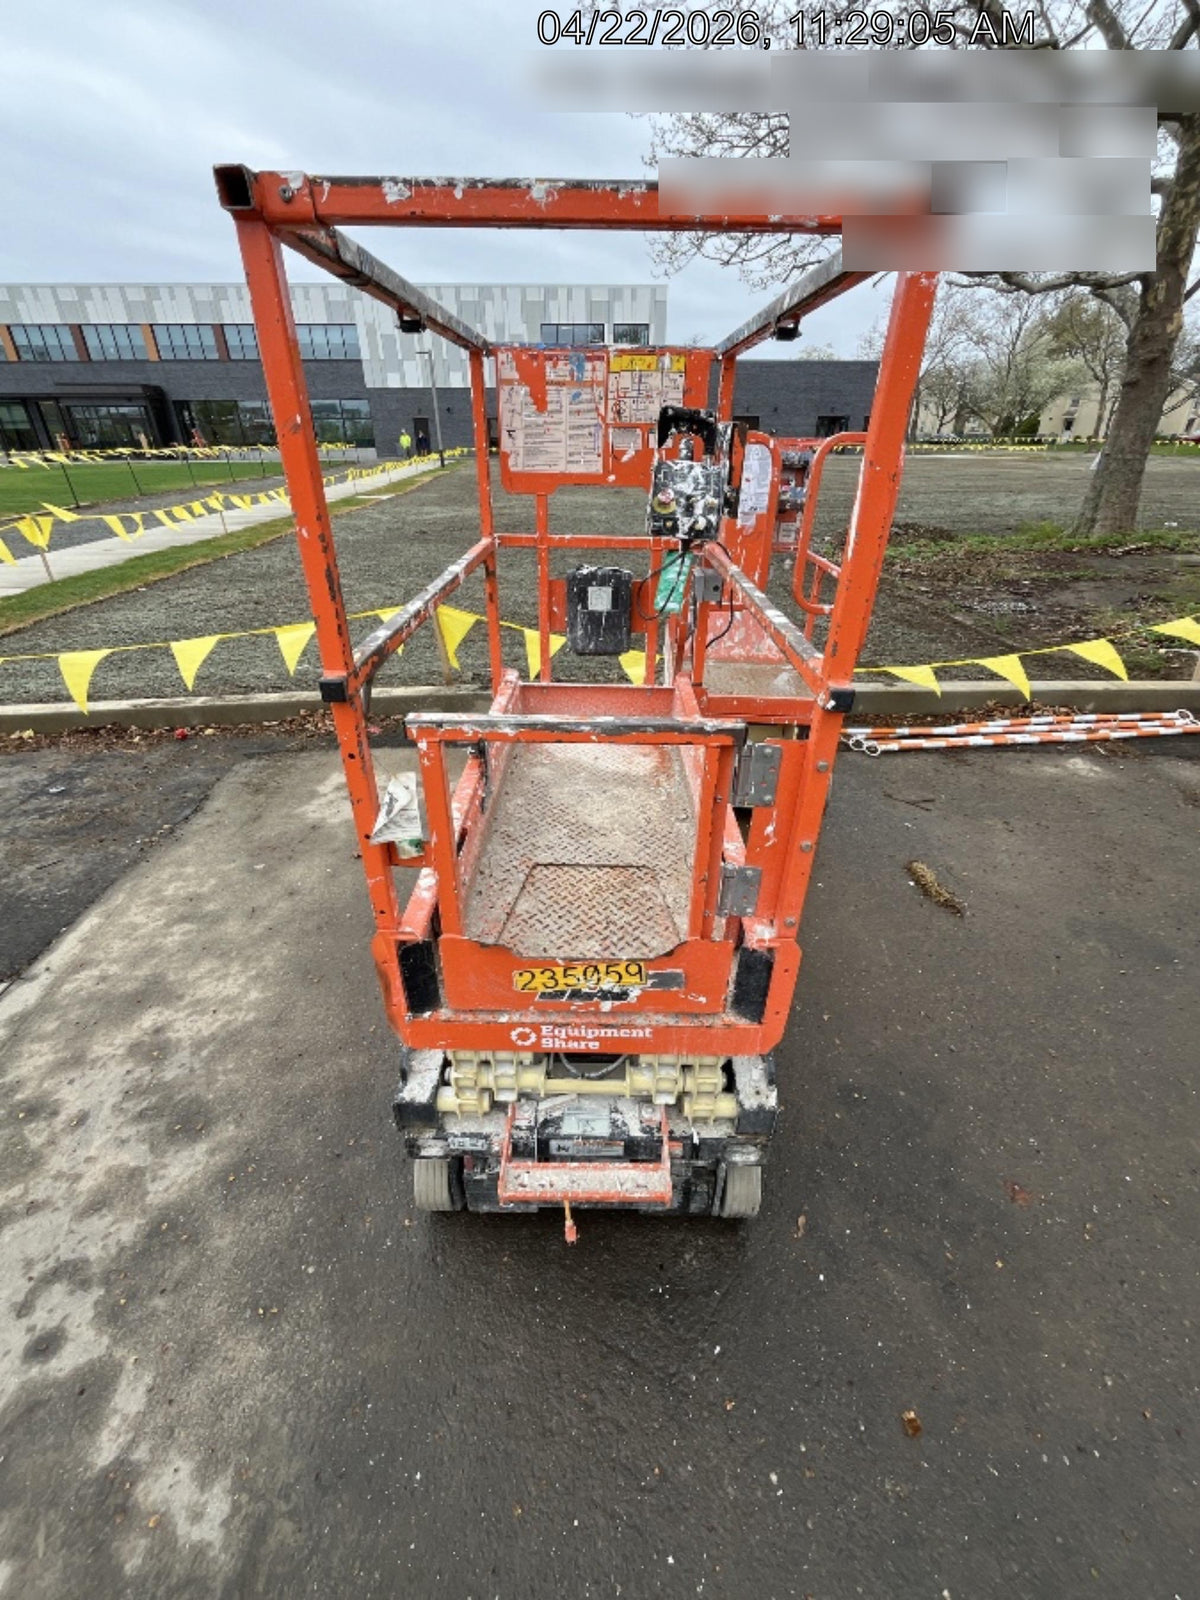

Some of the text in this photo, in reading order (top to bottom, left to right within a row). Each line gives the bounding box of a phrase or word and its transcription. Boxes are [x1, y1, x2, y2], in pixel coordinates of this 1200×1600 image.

[516, 961, 646, 992] 235059
[541, 1025, 653, 1039] Equipment
[541, 1037, 600, 1050] Share
